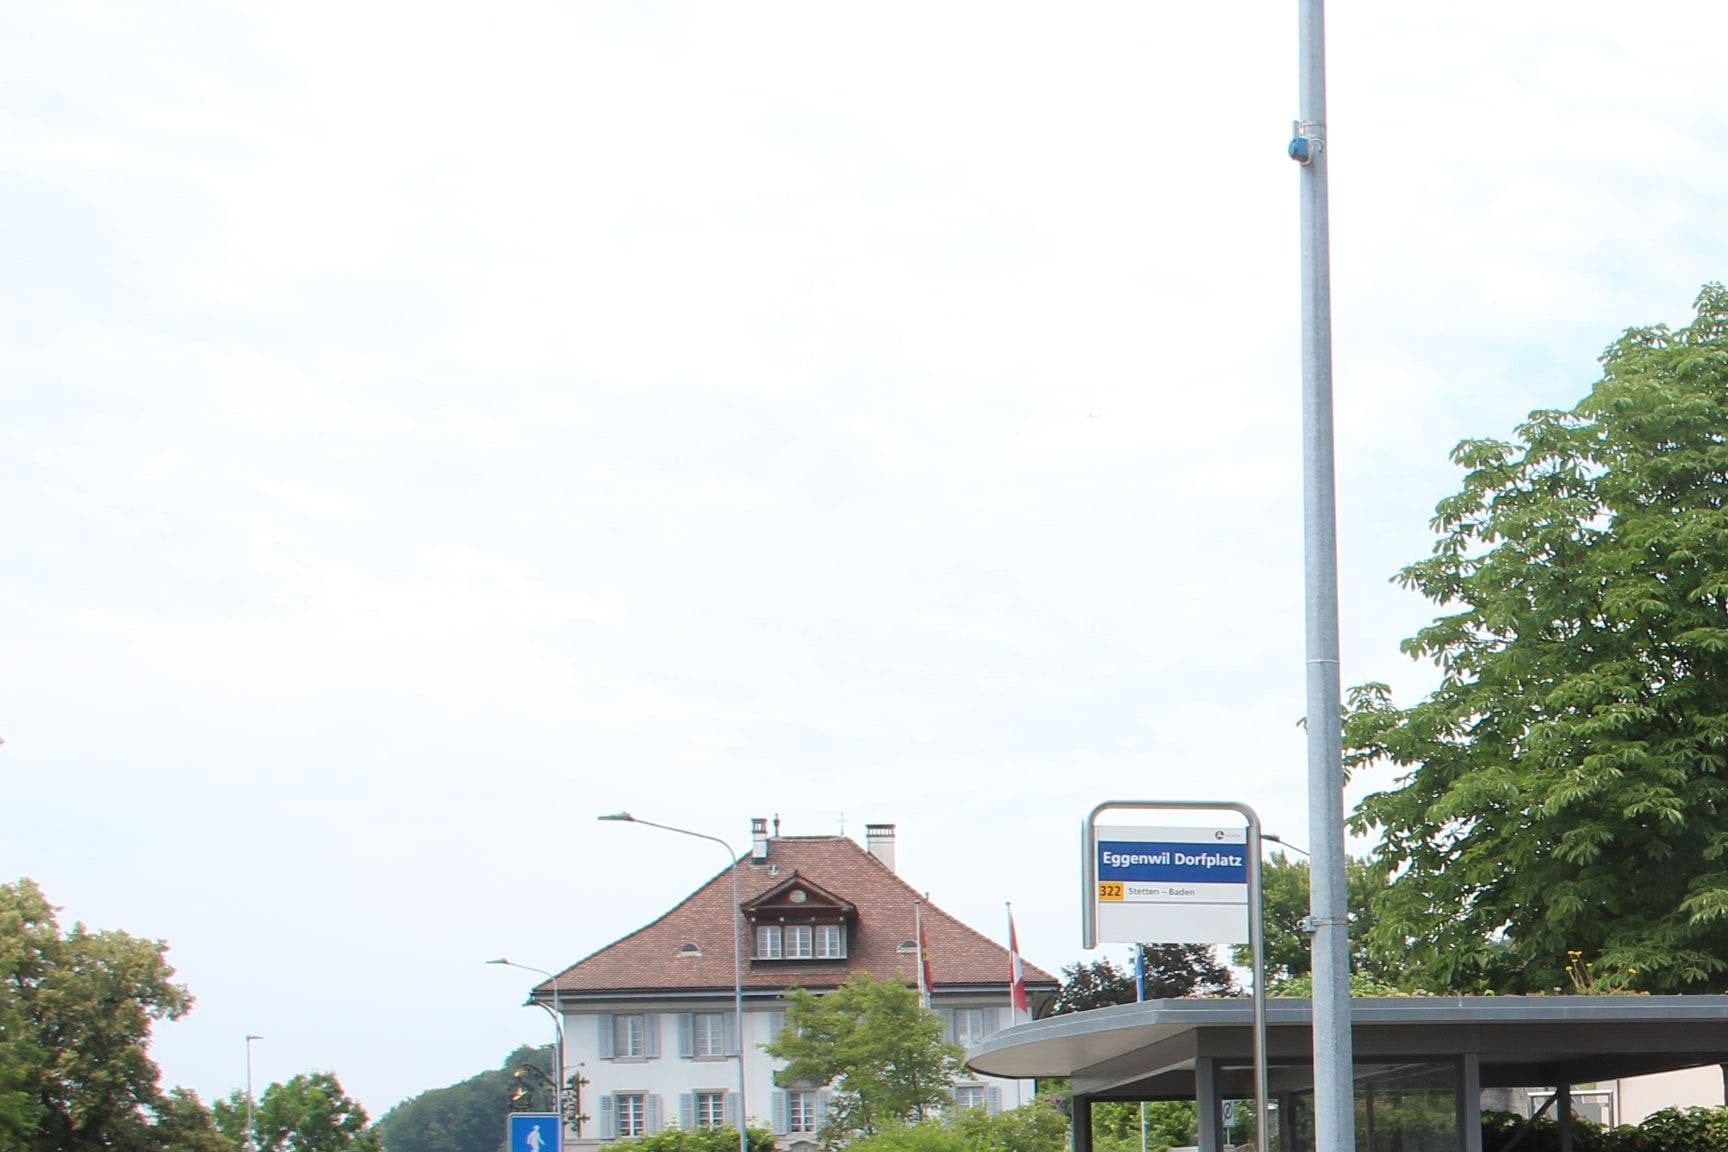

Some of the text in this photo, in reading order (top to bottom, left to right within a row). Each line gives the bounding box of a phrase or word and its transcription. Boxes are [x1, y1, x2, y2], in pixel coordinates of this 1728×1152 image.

[1103, 851, 1242, 868] Eggenwil Dorfplatz
[1100, 886, 1121, 896] 322
